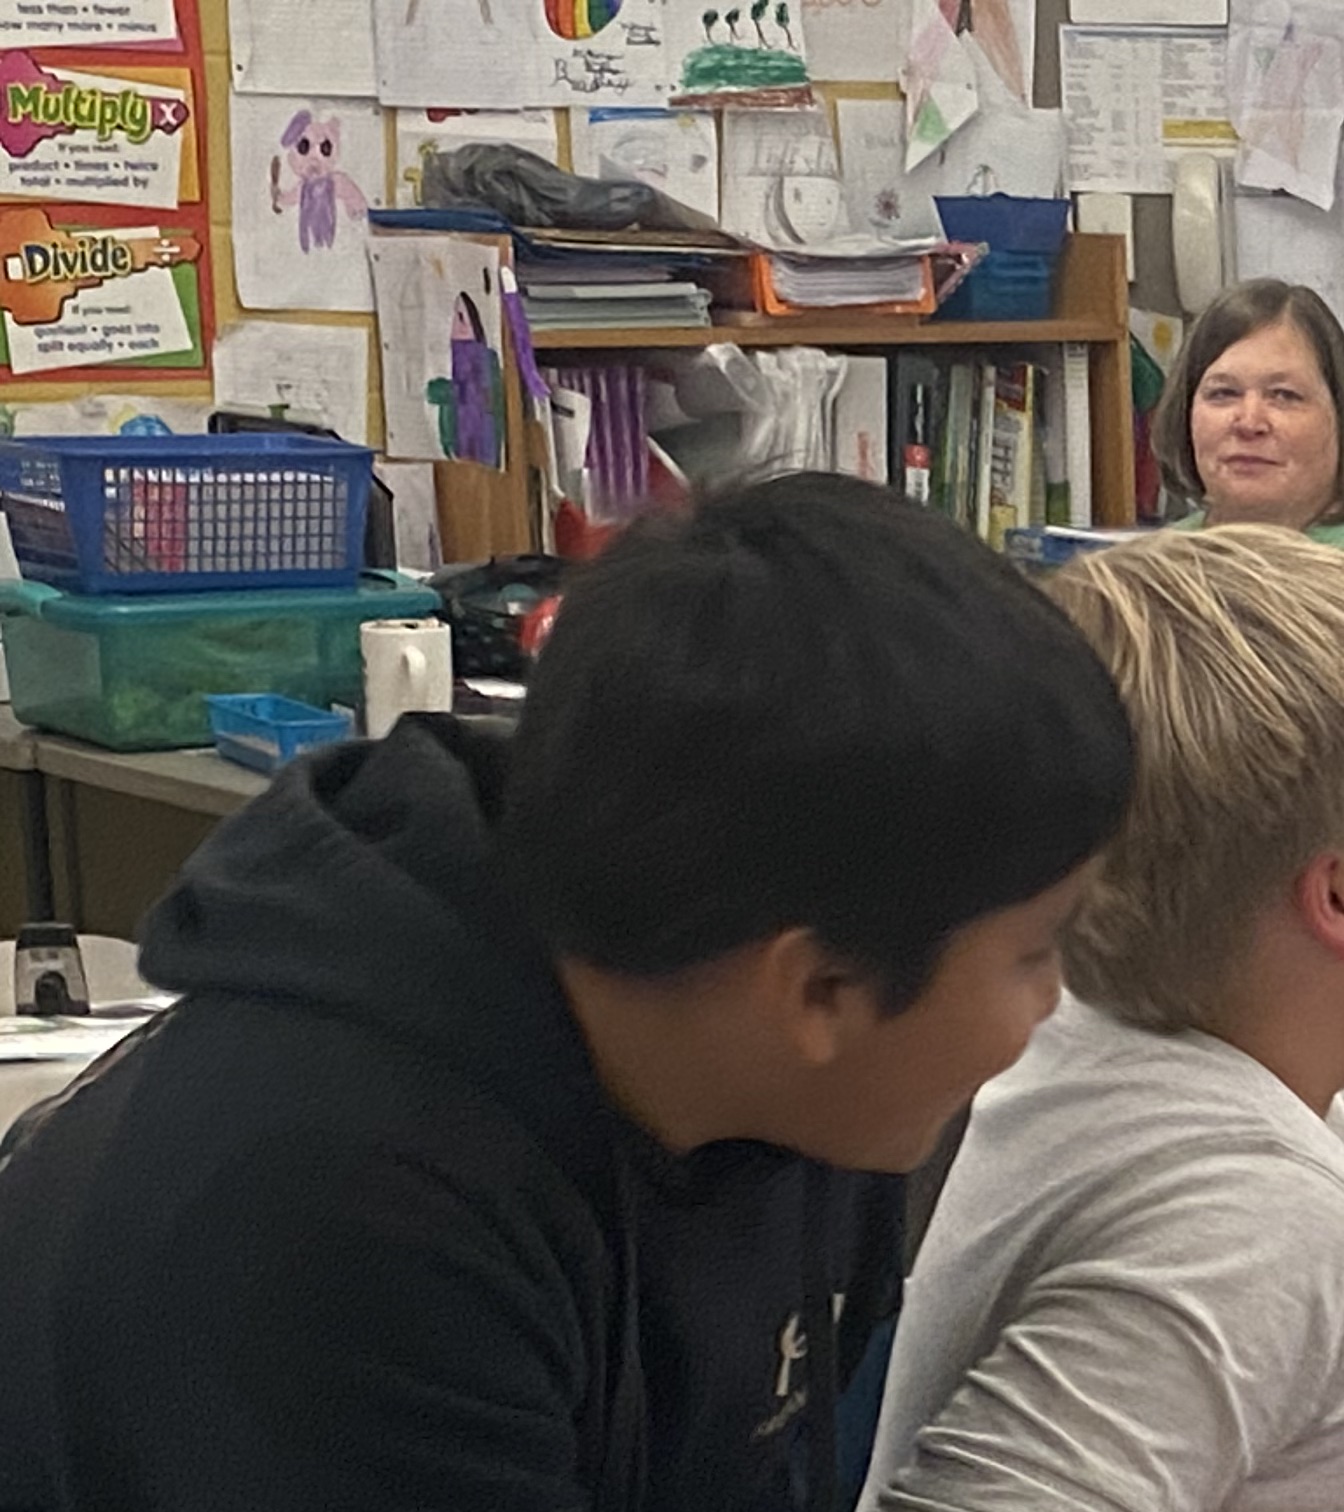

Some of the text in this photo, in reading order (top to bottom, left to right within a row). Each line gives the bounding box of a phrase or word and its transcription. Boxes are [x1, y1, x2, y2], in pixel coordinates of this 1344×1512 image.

[8, 83, 152, 144] Multiply
[65, 177, 129, 189] multiplied
[132, 177, 149, 189] by
[22, 236, 132, 284] Divide
